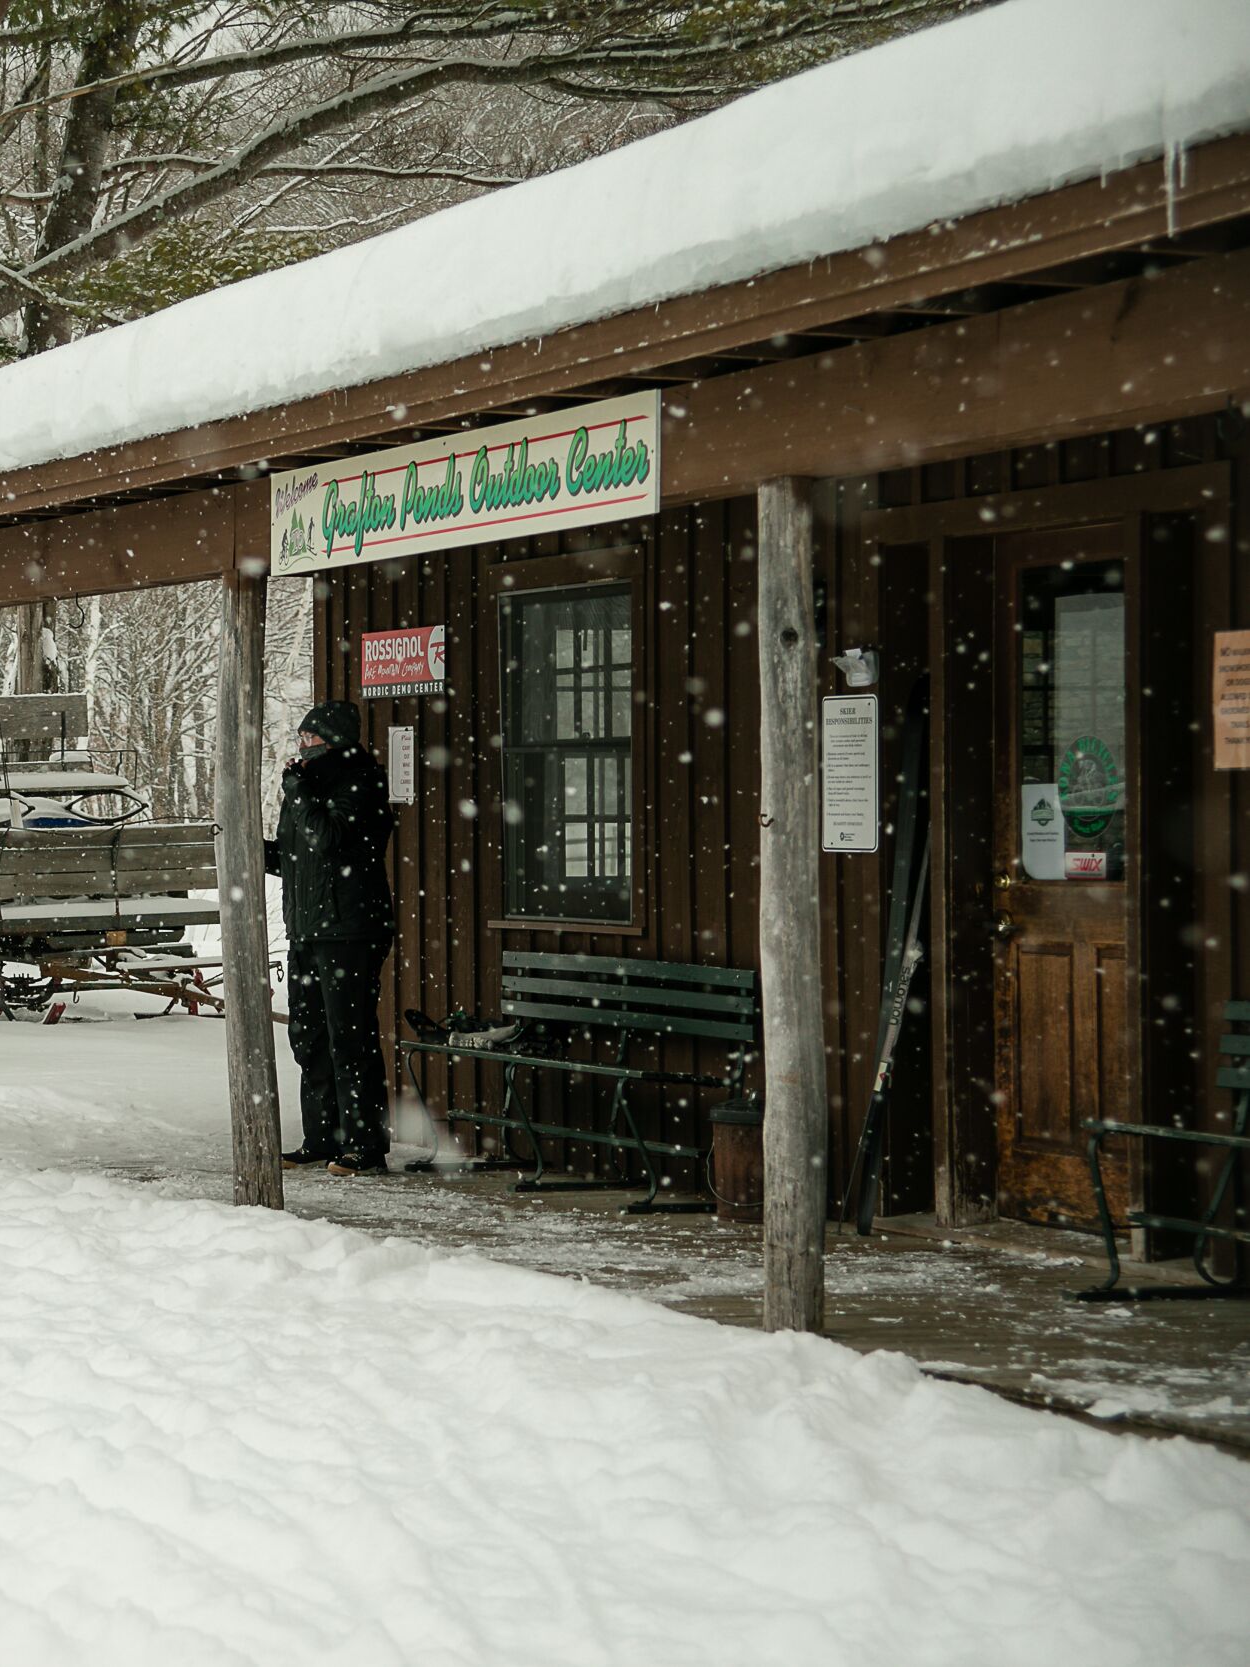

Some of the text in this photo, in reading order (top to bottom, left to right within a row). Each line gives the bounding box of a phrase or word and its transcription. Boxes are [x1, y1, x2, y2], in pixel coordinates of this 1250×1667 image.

[275, 472, 319, 518] Welcome
[322, 419, 650, 559] Grafton Ponds Outdoor Center
[365, 635, 425, 662] ROSSIGNOL
[362, 681, 444, 698] NORDIC DEMO CENTER
